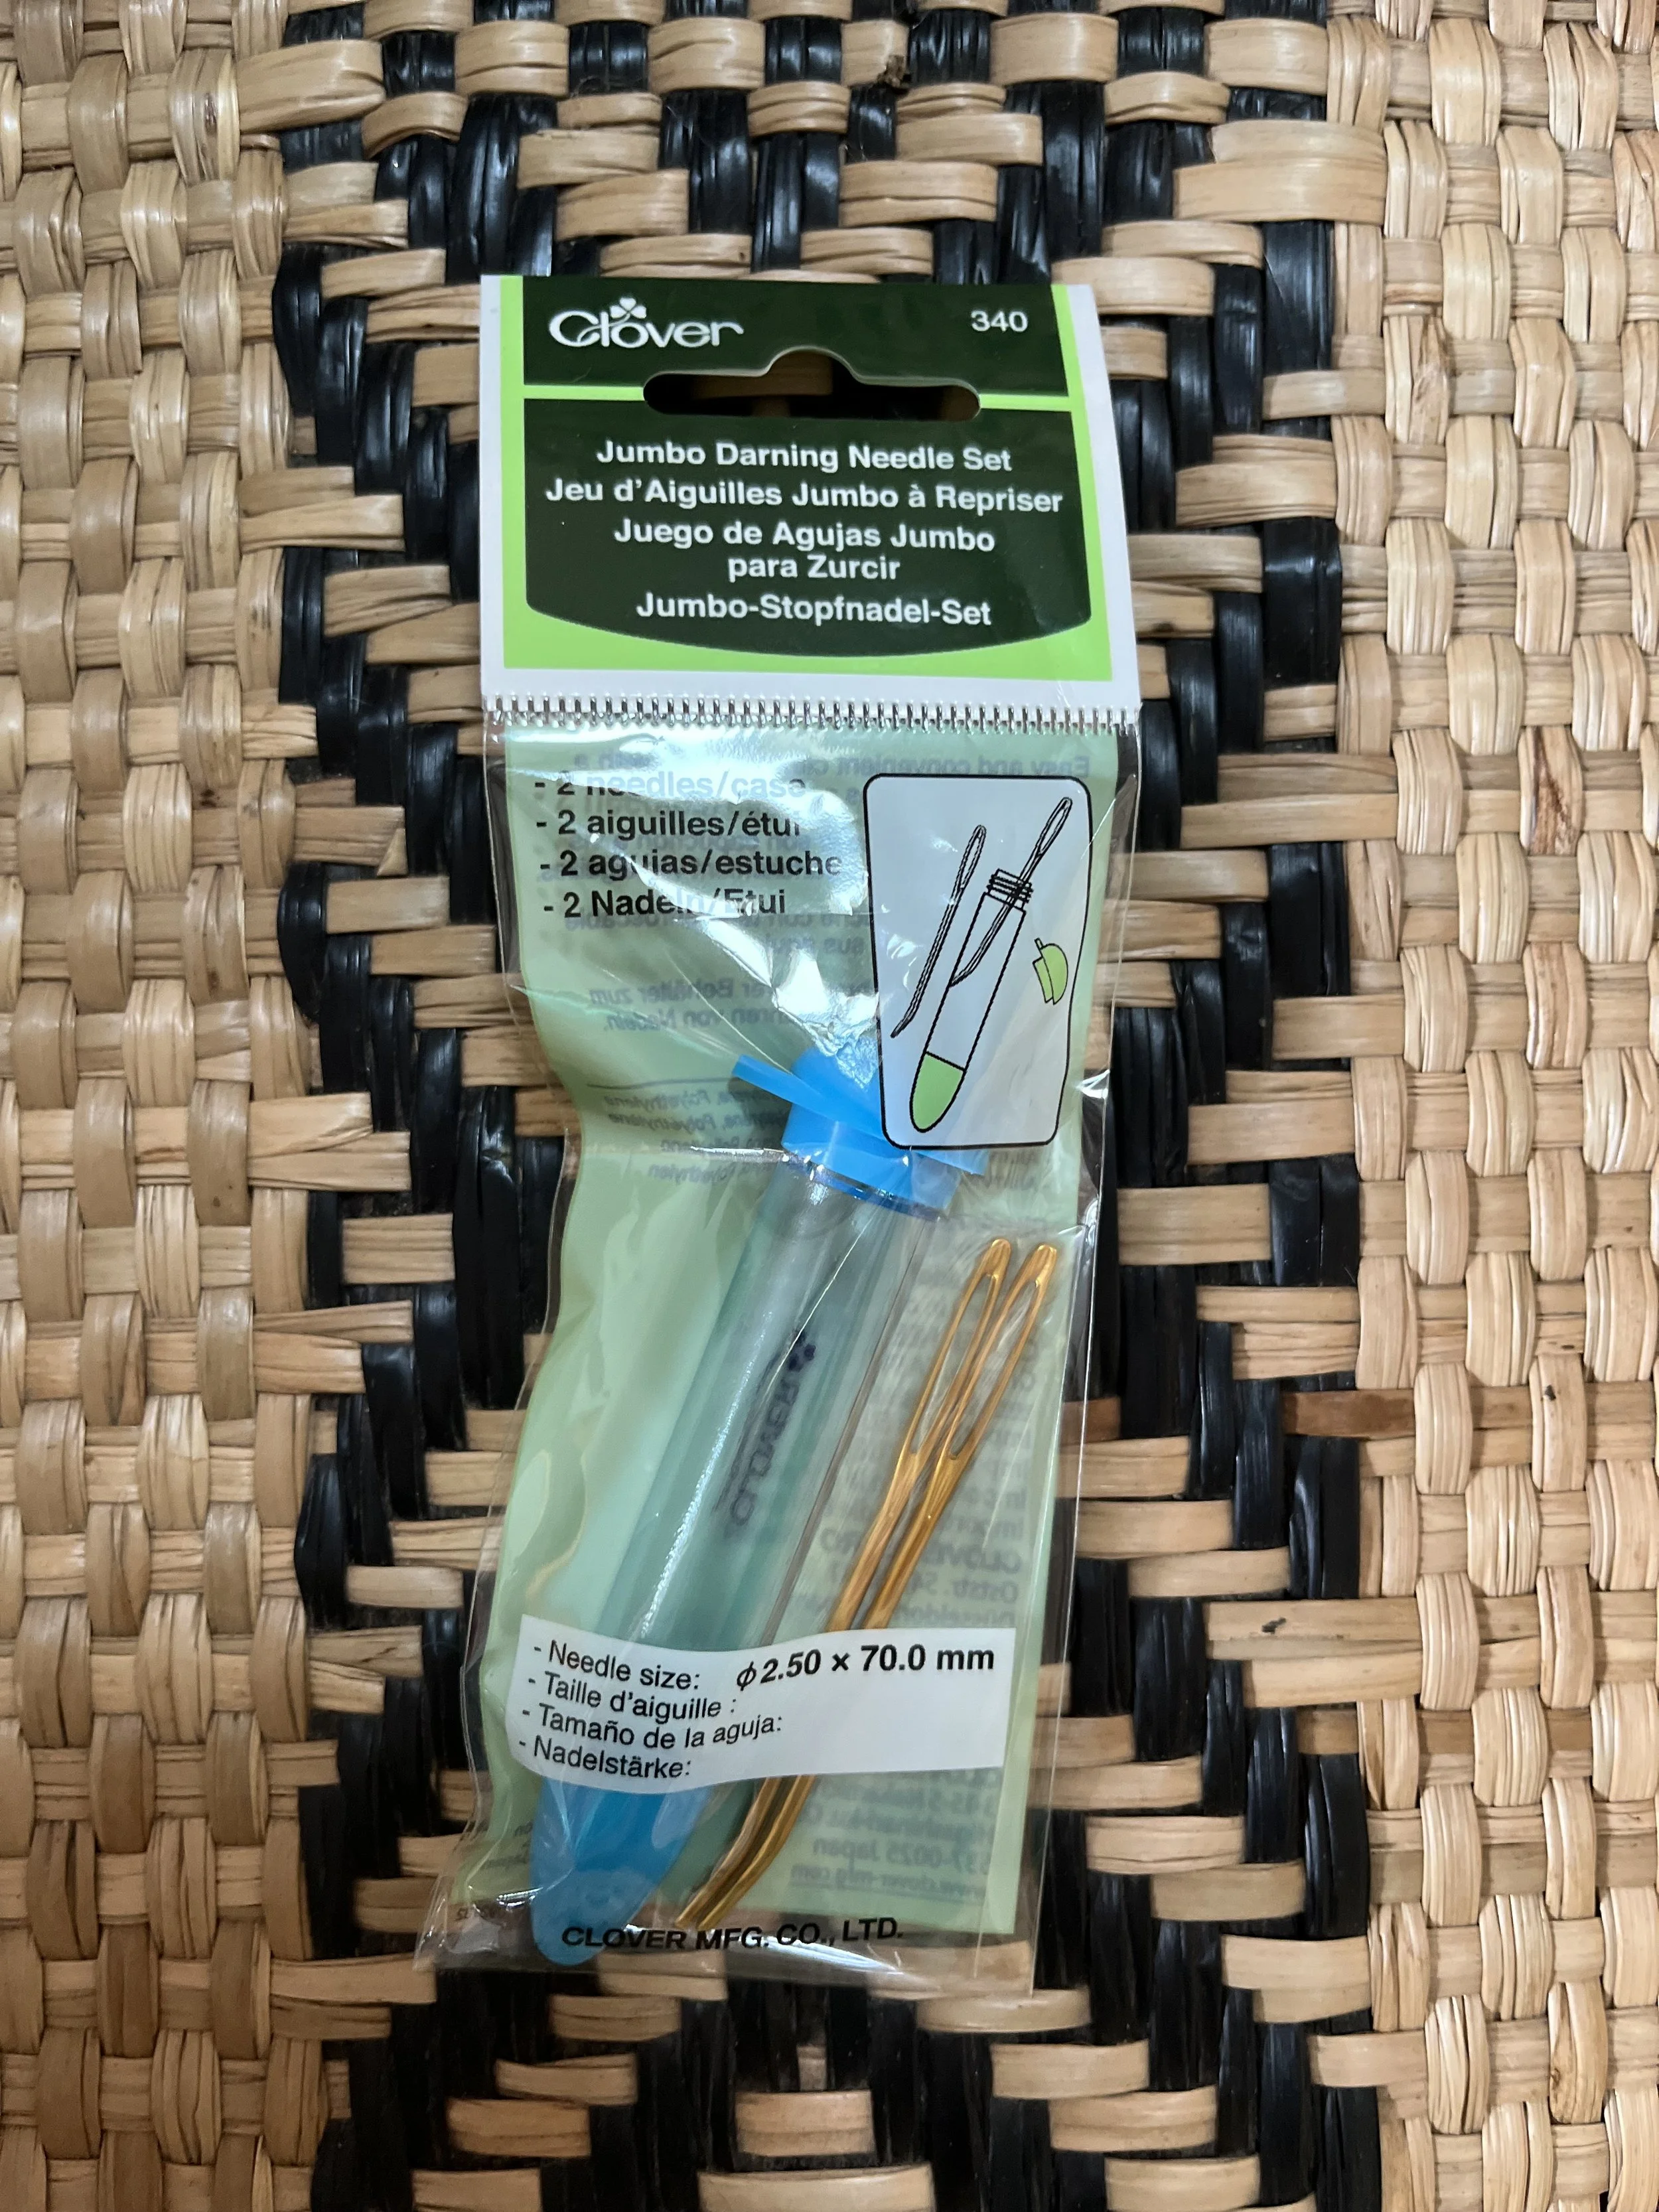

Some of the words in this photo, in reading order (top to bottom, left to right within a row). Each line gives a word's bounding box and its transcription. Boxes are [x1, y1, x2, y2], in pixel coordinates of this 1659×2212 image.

[549, 308, 744, 348] Clover
[970, 309, 1029, 332] 340
[597, 439, 706, 465] Jumbo
[715, 441, 838, 474] Darning
[848, 445, 955, 469] Needle
[962, 447, 1013, 472] Set
[545, 477, 603, 502] Jeu
[614, 478, 783, 510] d'Aiguilles
[792, 482, 899, 508] Jumbo
[908, 483, 926, 508] à
[935, 484, 1063, 516] Repriser
[614, 518, 714, 550] Juego
[723, 520, 763, 545] de
[772, 520, 881, 552] Agujas
[891, 523, 995, 552] Jumbo
[728, 557, 798, 583] para
[806, 553, 901, 579] Zurcir
[636, 591, 992, 627] Jumbo-Stopfnadel-Set
[557, 772, 575, 795] 2
[558, 809, 576, 835] 2
[560, 850, 578, 876] 2
[563, 892, 581, 919] 2
[548, 1639, 632, 1682] Needle
[640, 1664, 701, 1690] size:
[861, 1644, 926, 1671] 70.0
[936, 1649, 995, 1670] mm
[544, 1670, 602, 1708] Taille
[609, 1690, 722, 1725] d'aiguille
[538, 1702, 634, 1746] Tamaño
[643, 1726, 676, 1749] de
[684, 1727, 705, 1748] la
[713, 1714, 782, 1745] aguja:
[533, 1734, 691, 1779] Nadelstärke:
[561, 1926, 685, 1949] CLOVER
[695, 1926, 769, 1951] MFG.
[776, 1923, 835, 1947] CO.,
[841, 1916, 904, 1943] LTD.
